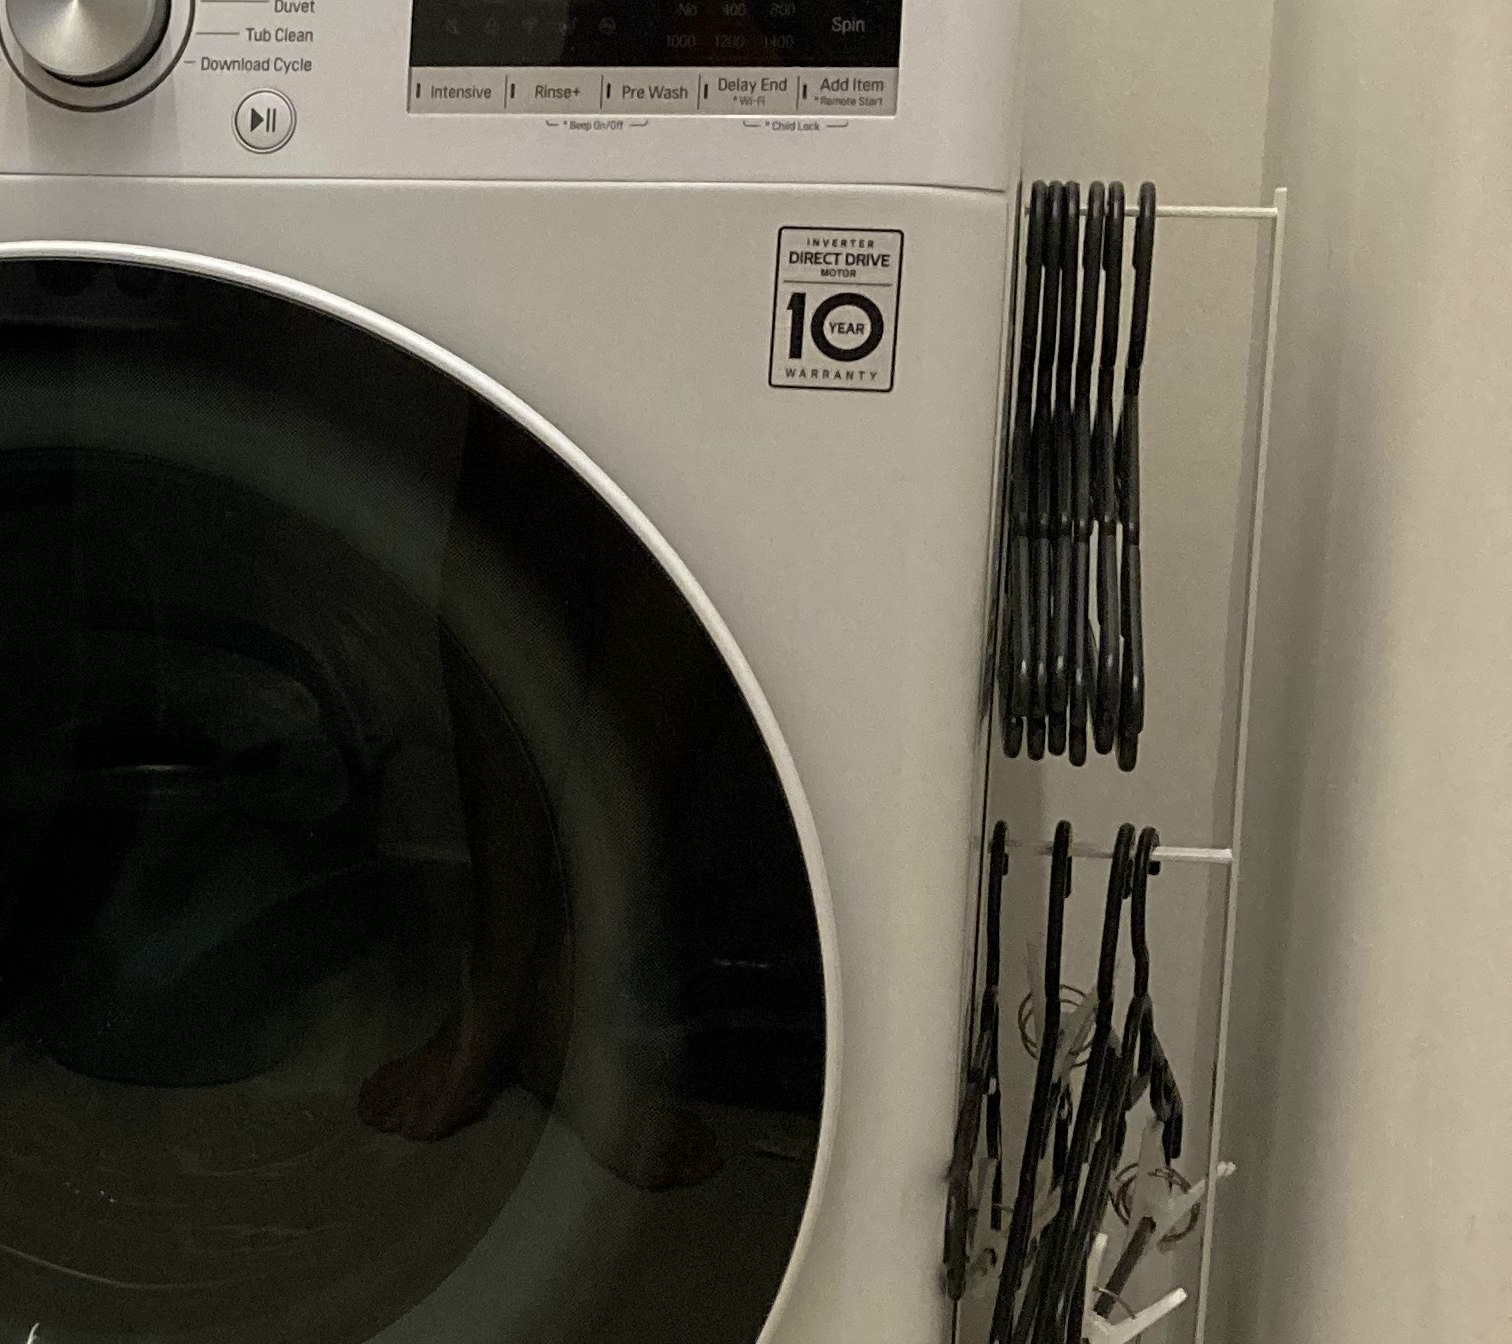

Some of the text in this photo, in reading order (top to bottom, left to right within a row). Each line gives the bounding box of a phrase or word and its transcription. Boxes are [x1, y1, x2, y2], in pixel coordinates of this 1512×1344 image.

[831, 17, 866, 35] Spin
[246, 28, 313, 42] Tub Clean
[201, 56, 312, 73] Download Cycle
[718, 77, 787, 94] Delay End
[820, 77, 883, 91] Add Item
[430, 85, 492, 99] Intensive
[535, 84, 581, 99] Rinse+
[622, 84, 688, 100] Pre Wash
[859, 97, 883, 106] Start
[569, 121, 623, 130] Beep On/Off
[772, 121, 819, 131] Child Lock
[807, 238, 875, 248] INVERTER
[789, 251, 891, 267] DIRECT DRIVE
[821, 269, 856, 278] MOTOR
[787, 292, 884, 362] 10
[829, 321, 865, 335] YEAR
[785, 368, 878, 381] WARRANTY
